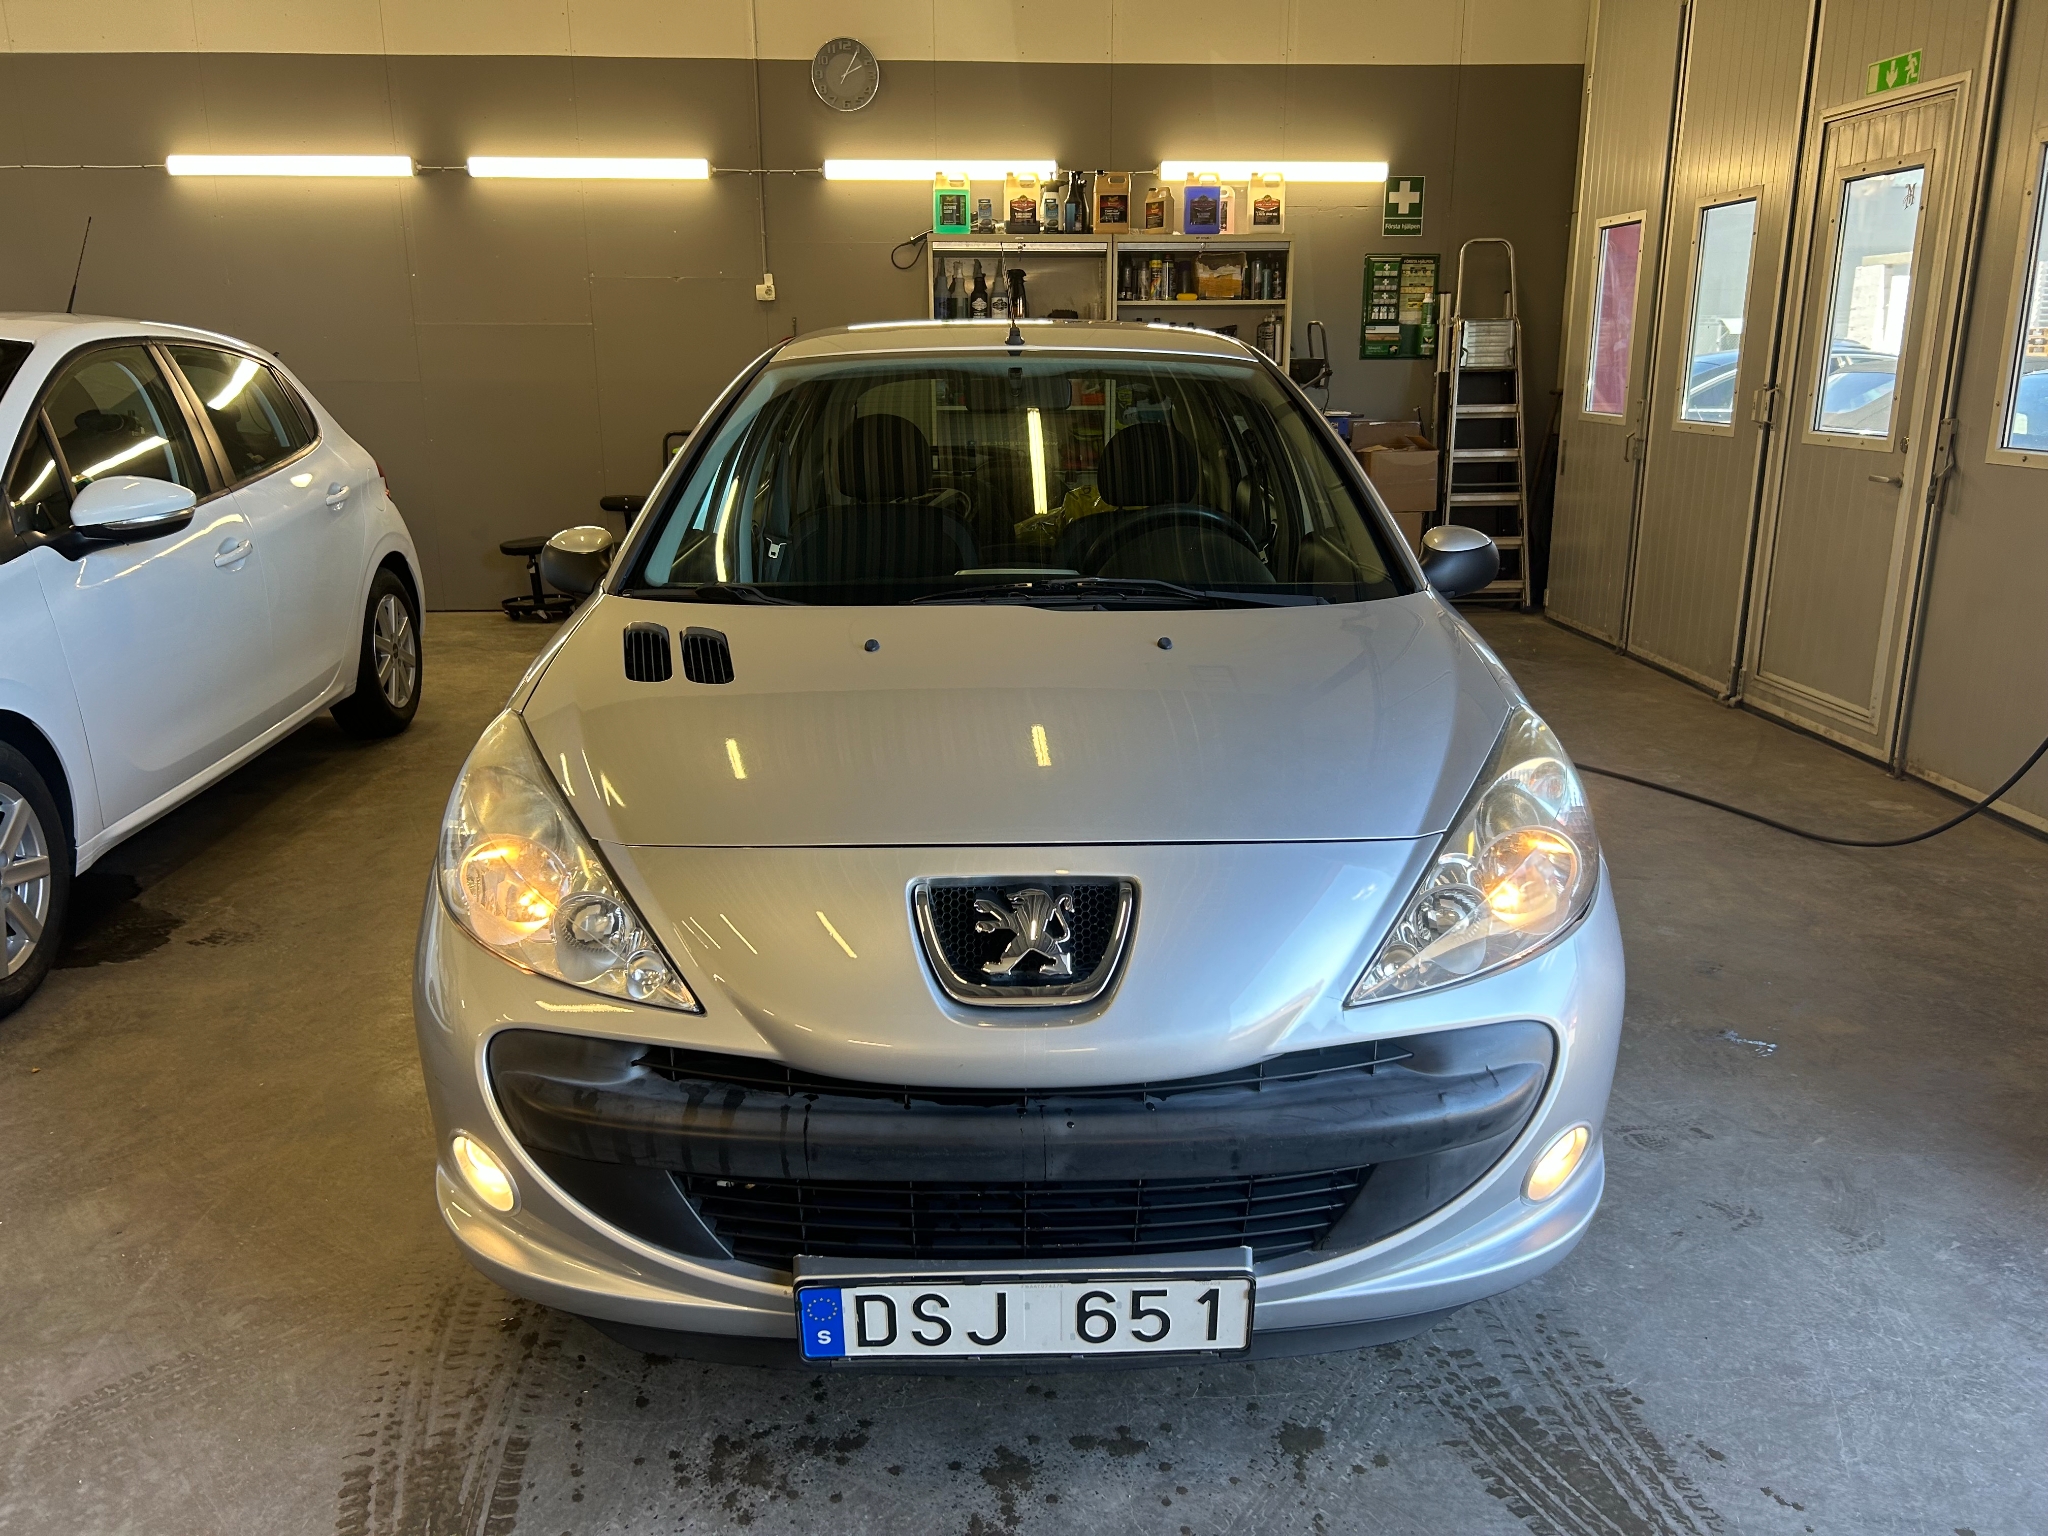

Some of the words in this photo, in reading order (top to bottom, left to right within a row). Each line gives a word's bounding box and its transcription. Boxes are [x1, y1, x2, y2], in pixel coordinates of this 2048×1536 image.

[827, 44, 836, 54] 11
[838, 40, 851, 50] 12
[855, 45, 860, 53] 1
[818, 55, 828, 65] 10
[864, 56, 873, 66] 2
[815, 70, 823, 79] 9
[868, 70, 876, 80] 3
[819, 85, 828, 94] 8
[864, 86, 872, 95] 4
[829, 96, 837, 105] 7
[843, 100, 851, 109] 6
[856, 96, 864, 105] 5
[1402, 222, 1420, 231] hjälpen
[854, 1292, 1007, 1347] DSJ
[1075, 1288, 1221, 1344] 651
[816, 1329, 832, 1345] S
